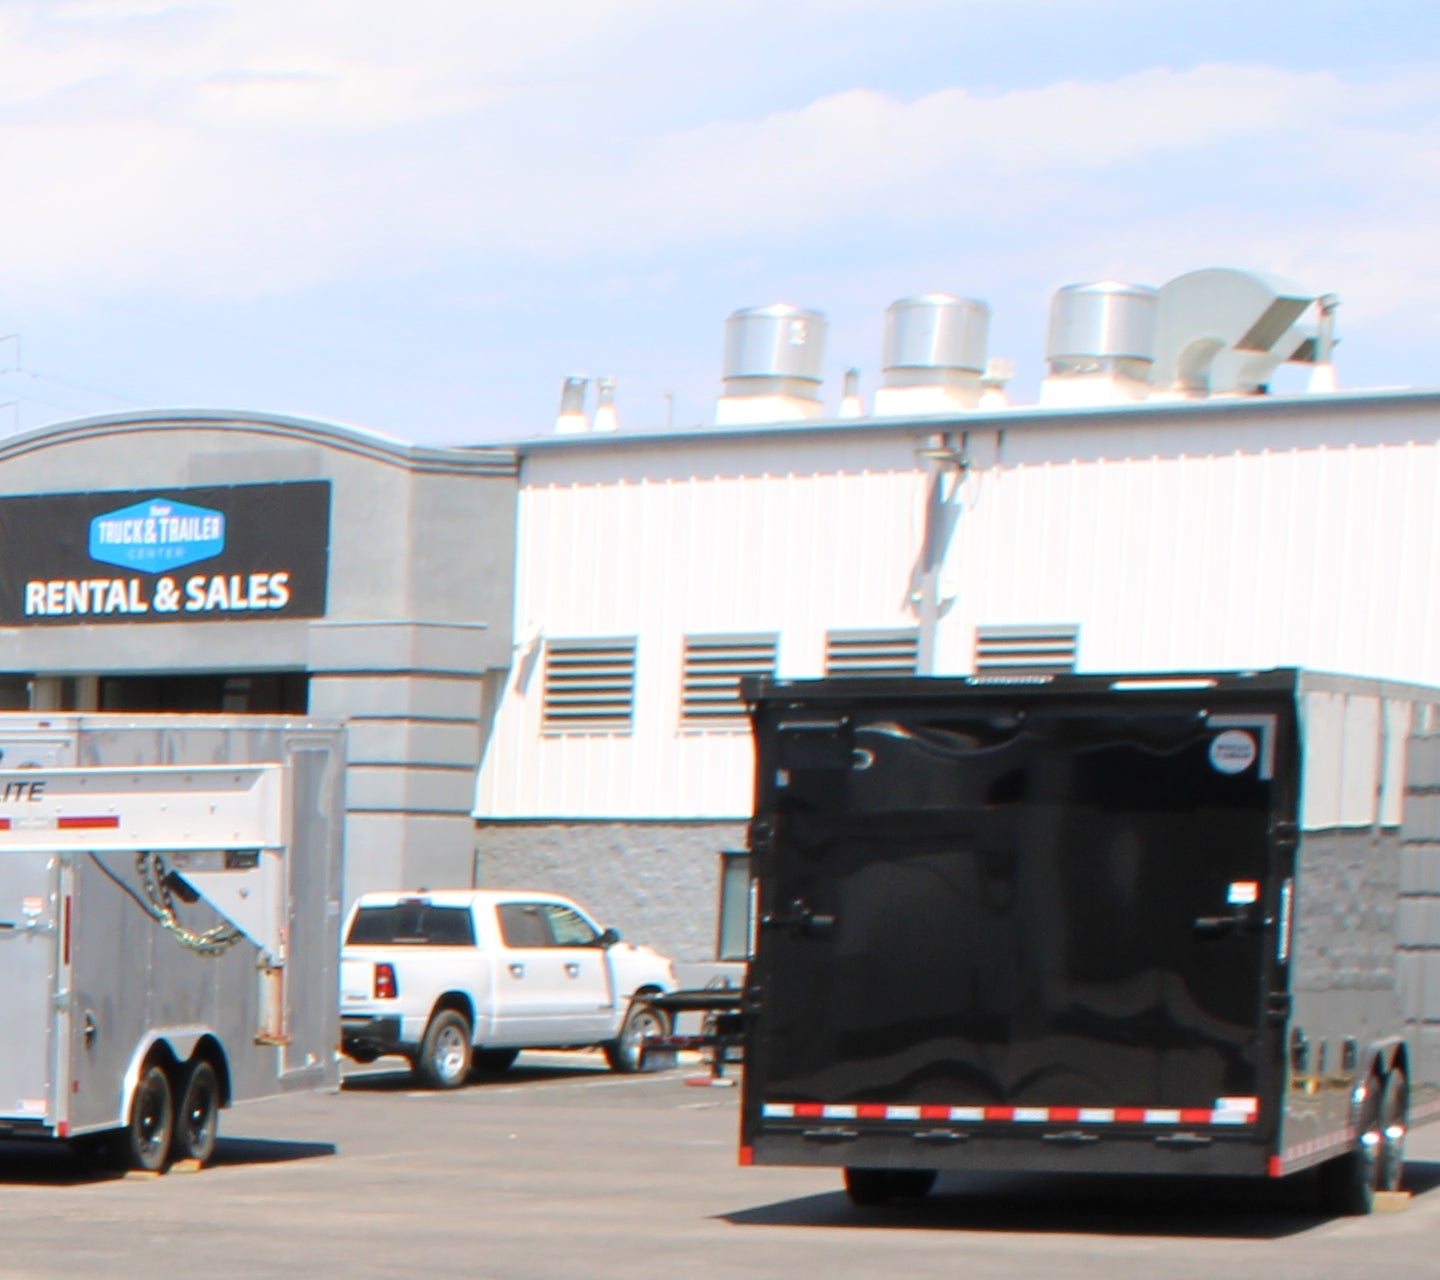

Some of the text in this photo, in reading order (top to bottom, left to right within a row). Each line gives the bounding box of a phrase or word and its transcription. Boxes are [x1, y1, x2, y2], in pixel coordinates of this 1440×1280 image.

[25, 572, 291, 616] RENTAL & SALES
